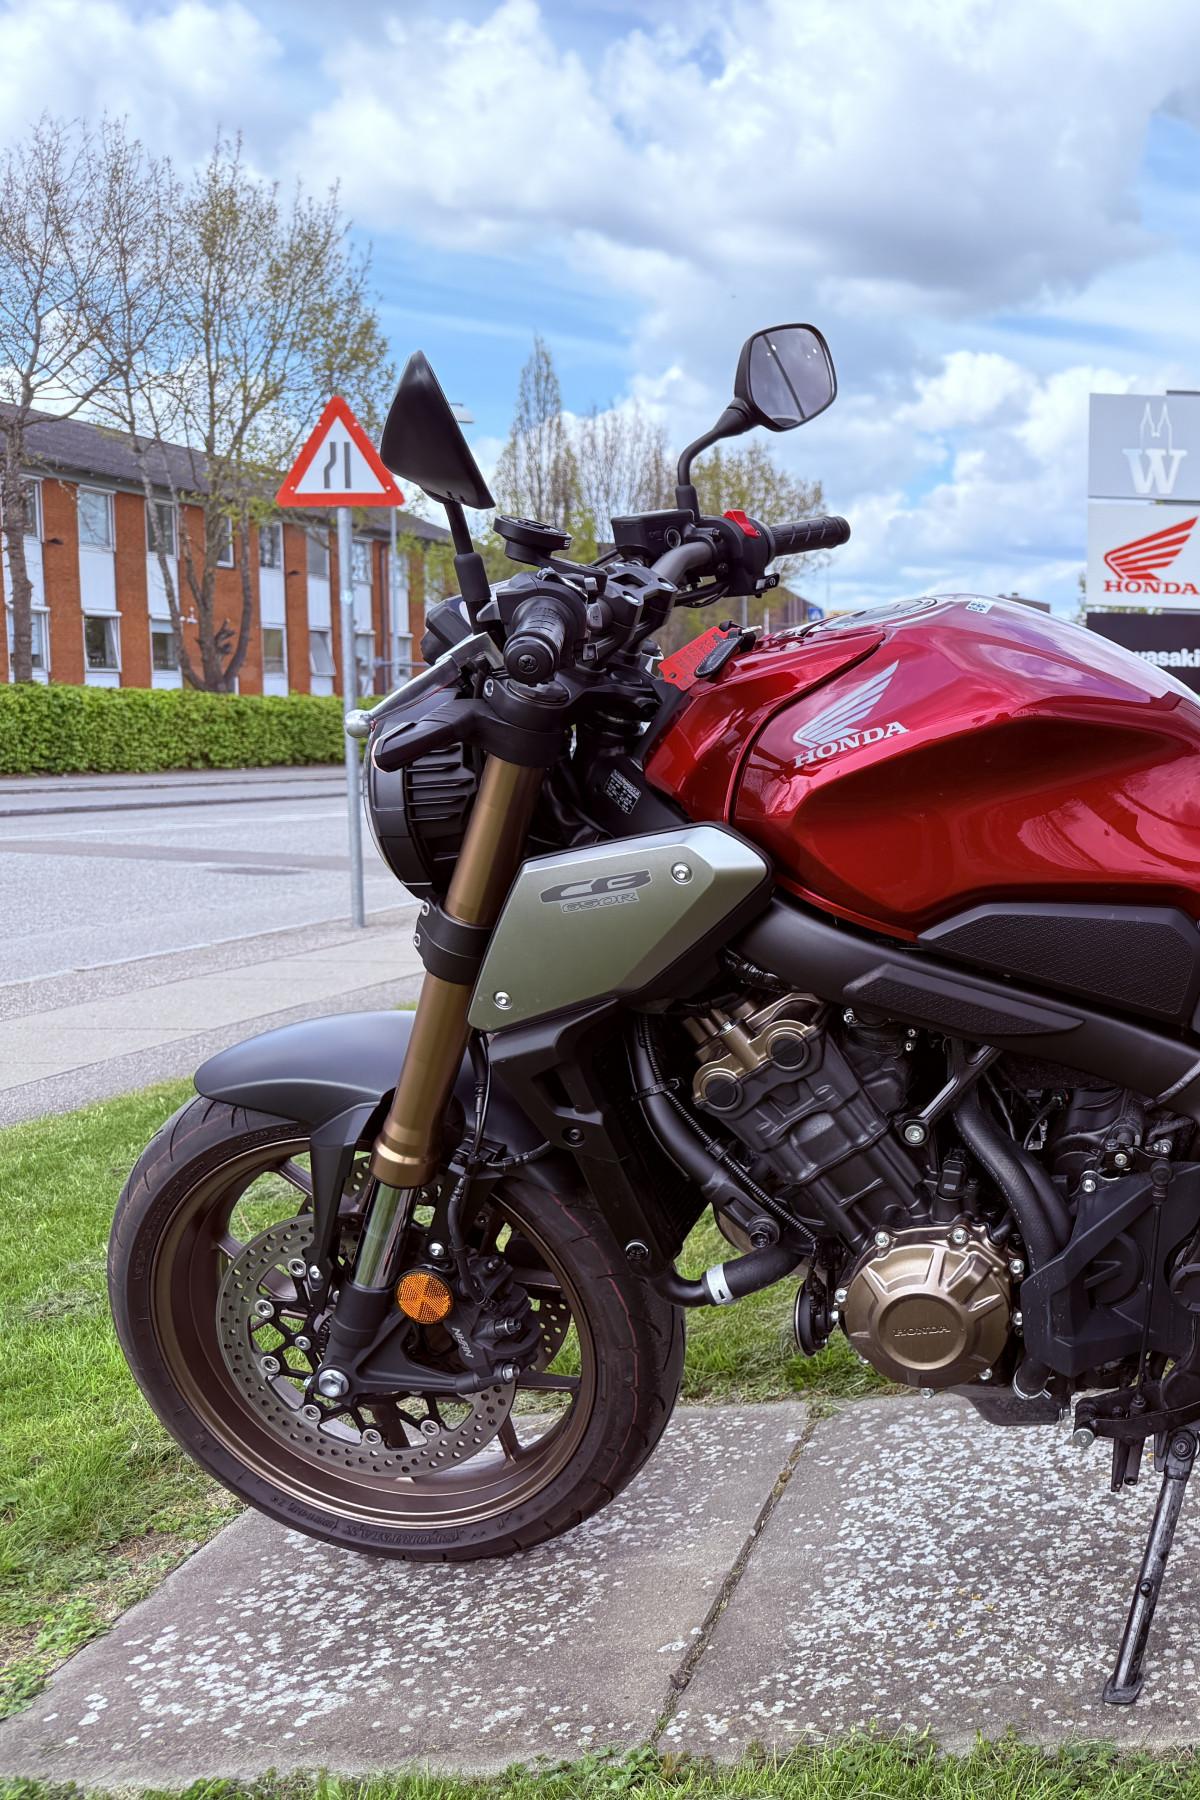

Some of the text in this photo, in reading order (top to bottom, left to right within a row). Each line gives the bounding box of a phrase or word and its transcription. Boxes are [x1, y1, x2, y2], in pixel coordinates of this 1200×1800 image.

[1122, 449, 1187, 494] W
[1104, 580, 1200, 595] HONDA
[794, 721, 909, 768] HONDA
[540, 870, 652, 902] CB
[893, 1326, 951, 1337] HONDA
